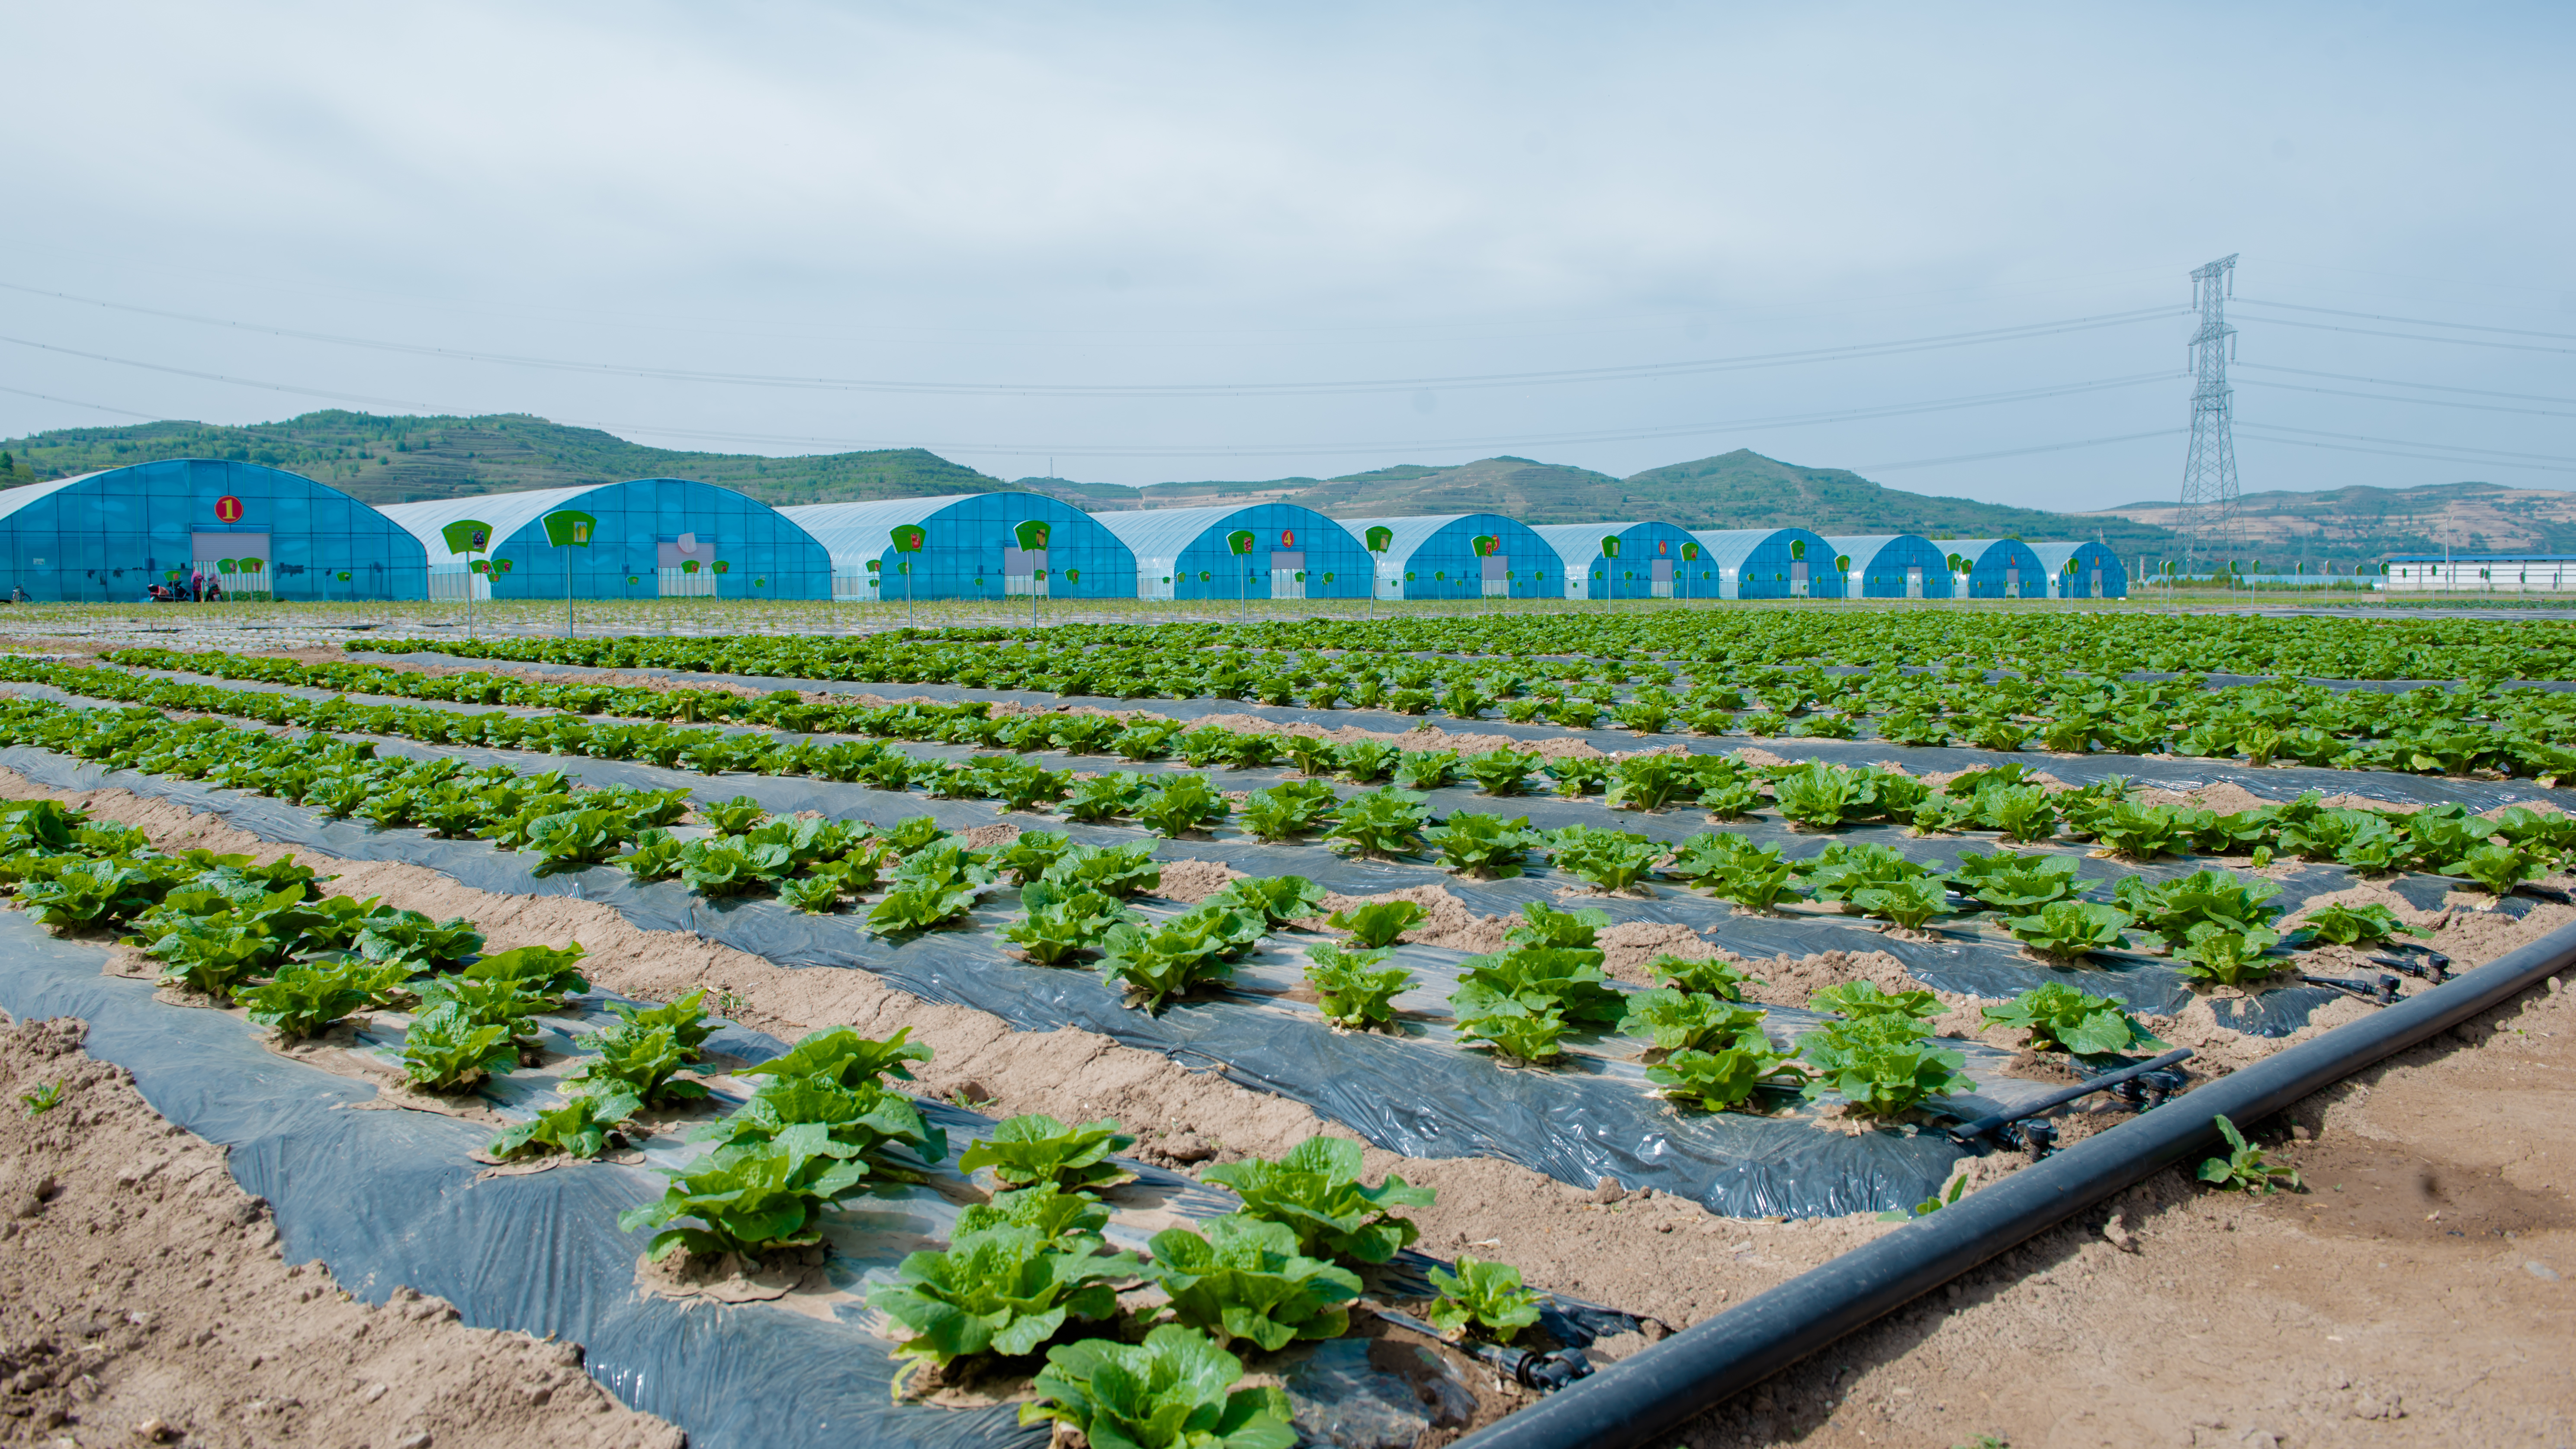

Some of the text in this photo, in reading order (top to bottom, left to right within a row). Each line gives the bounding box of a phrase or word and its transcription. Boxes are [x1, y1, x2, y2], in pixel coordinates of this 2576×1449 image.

[222, 499, 236, 519] 1
[1284, 532, 1291, 545] 4
[1660, 542, 1665, 553] 6
